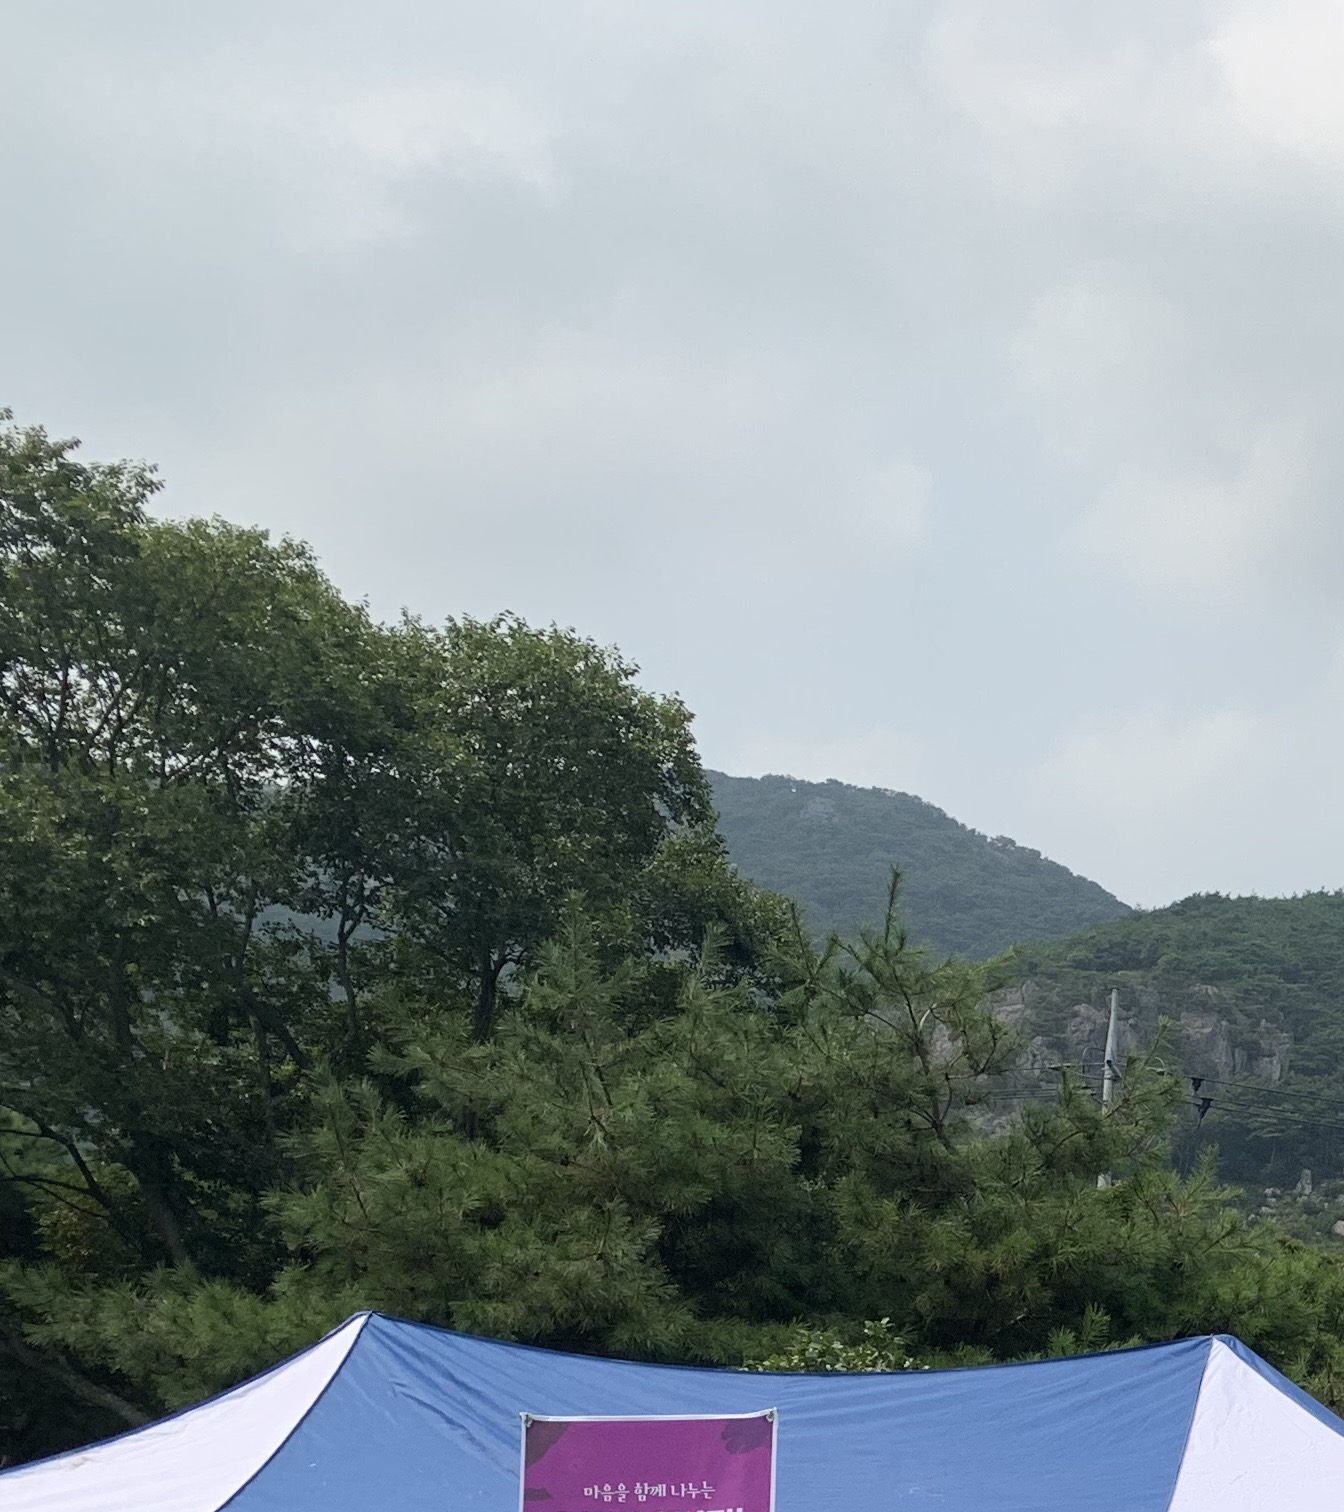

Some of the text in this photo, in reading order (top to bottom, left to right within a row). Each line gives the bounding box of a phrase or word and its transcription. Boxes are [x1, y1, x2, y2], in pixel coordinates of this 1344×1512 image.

[583, 1480, 716, 1502] 마음을 함께 나누는
